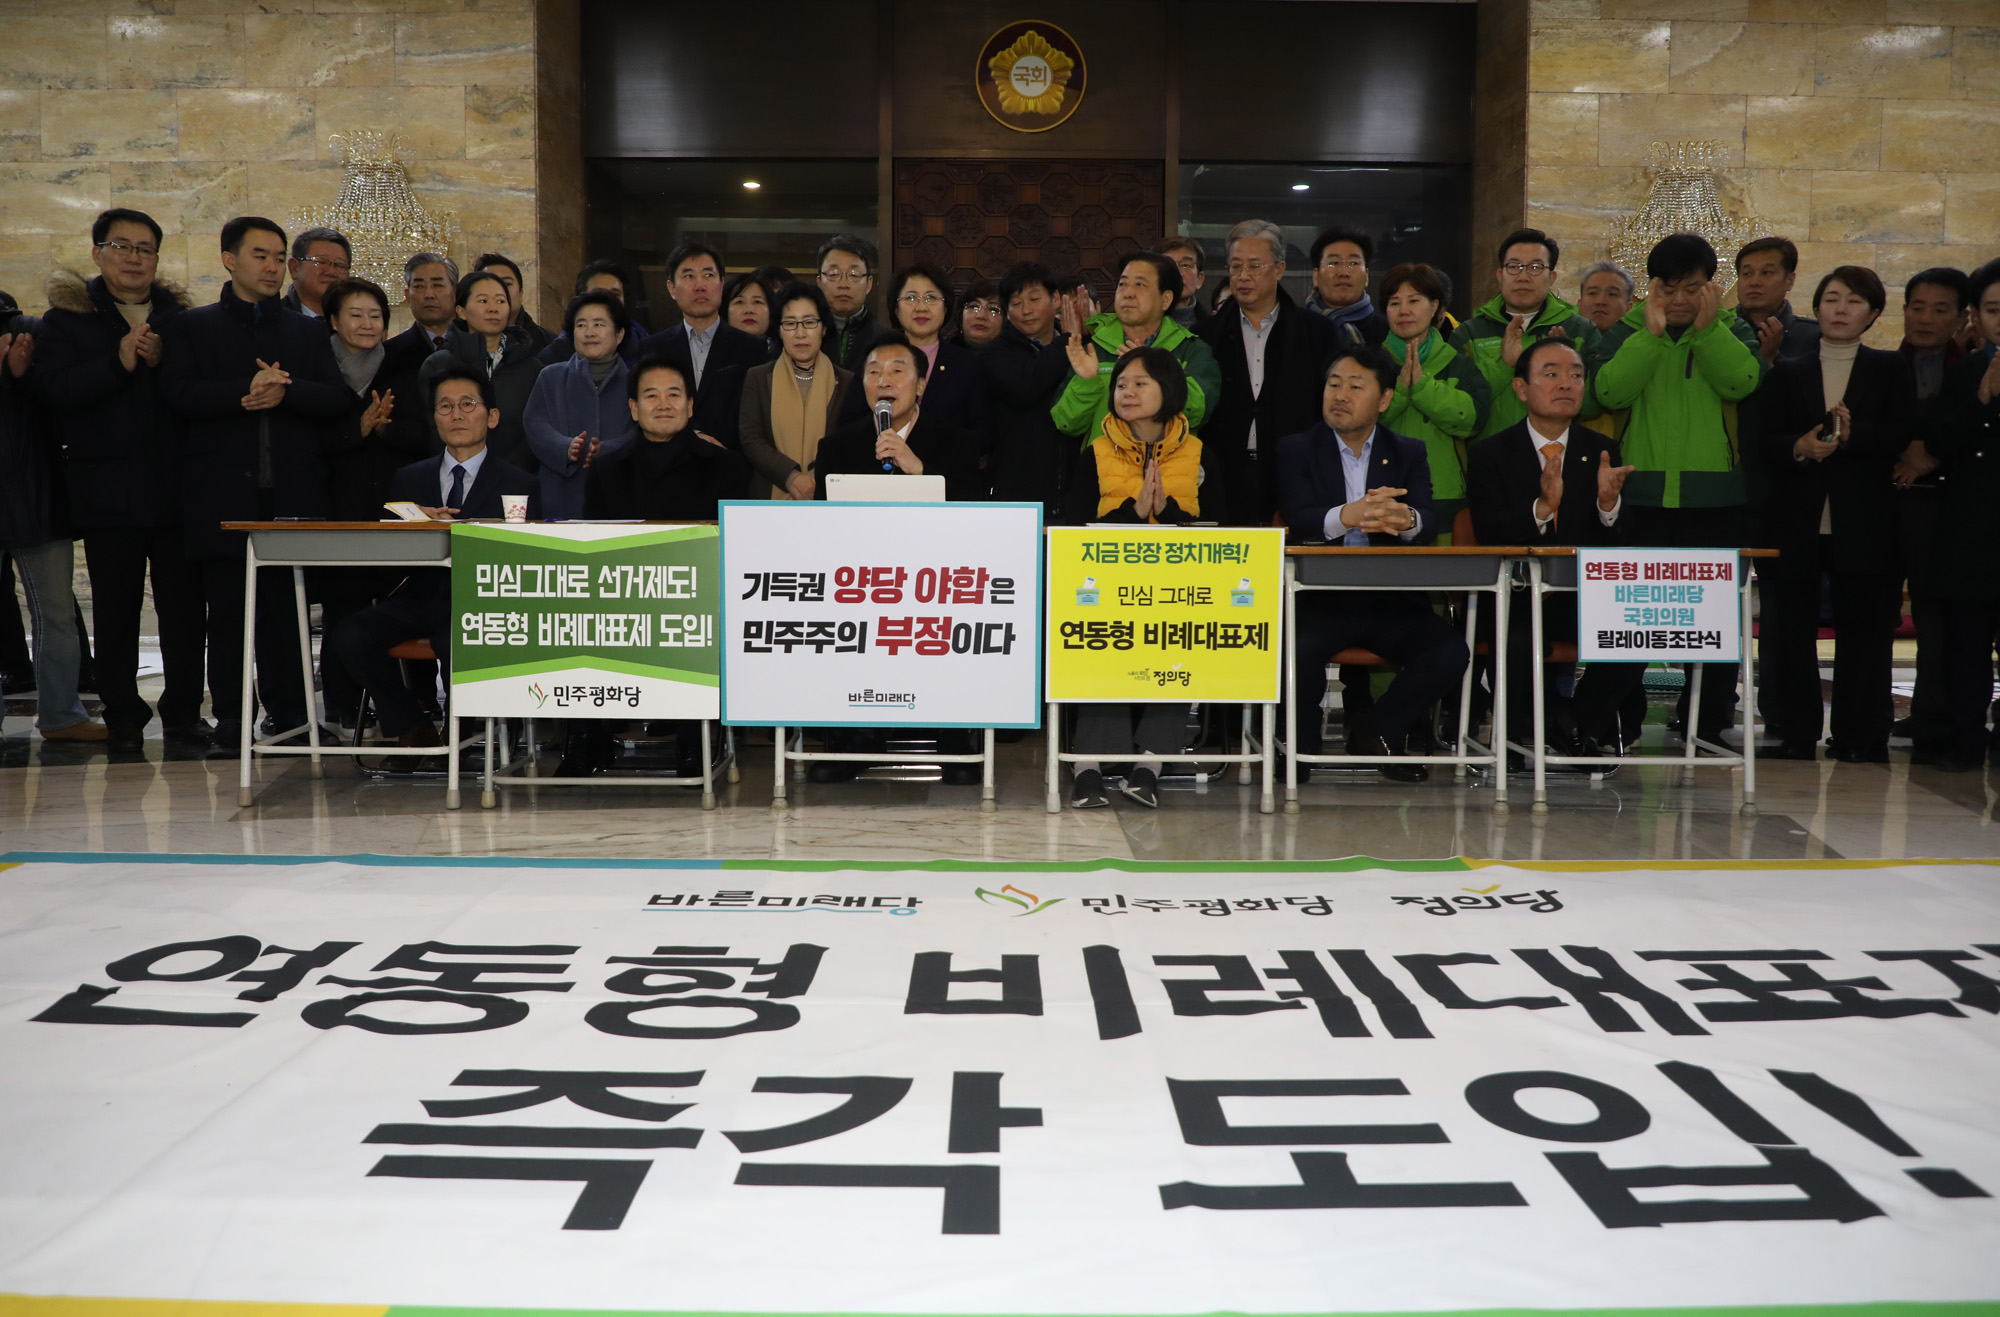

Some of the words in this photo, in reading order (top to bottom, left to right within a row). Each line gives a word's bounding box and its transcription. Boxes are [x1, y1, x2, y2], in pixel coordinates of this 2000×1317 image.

[1013, 66, 1048, 87] 국회
[1081, 542, 1120, 564] 지금
[1123, 542, 1161, 564] 당장
[1165, 542, 1250, 564] 정치개혁!
[476, 564, 591, 598] 민심그대로
[597, 565, 697, 599] 선거제도!
[1585, 561, 1638, 581] 연동형
[1644, 562, 1732, 581] 비례대표제
[742, 572, 826, 602] 기득권
[834, 566, 908, 604] 양당
[914, 566, 1015, 605] 야합은
[1118, 585, 1153, 606] 민심
[1158, 585, 1214, 606] 그대로
[1615, 585, 1704, 604] 바른미래당
[1624, 607, 1695, 627] 국회의원
[461, 611, 529, 646] 연동형
[538, 613, 652, 647] 비례대표제
[659, 614, 713, 647] 도입!
[743, 620, 868, 654] 민주주의
[875, 616, 1016, 656] 부정이다
[1059, 620, 1135, 651] 연동형
[1143, 621, 1269, 651] 비례대표제
[1597, 630, 1722, 649] 릴레이동조단식
[1153, 670, 1192, 687] 정의당
[553, 685, 642, 707] 민주평화당
[848, 688, 916, 710] 바른미래당
[641, 890, 923, 916] 바른미래당
[1081, 894, 1333, 917] 민주평화당
[1390, 889, 1565, 917] 정의당
[29, 934, 829, 1040] 연동형
[361, 1069, 1043, 1236] 즉각
[1159, 1060, 1992, 1229] 도입!
